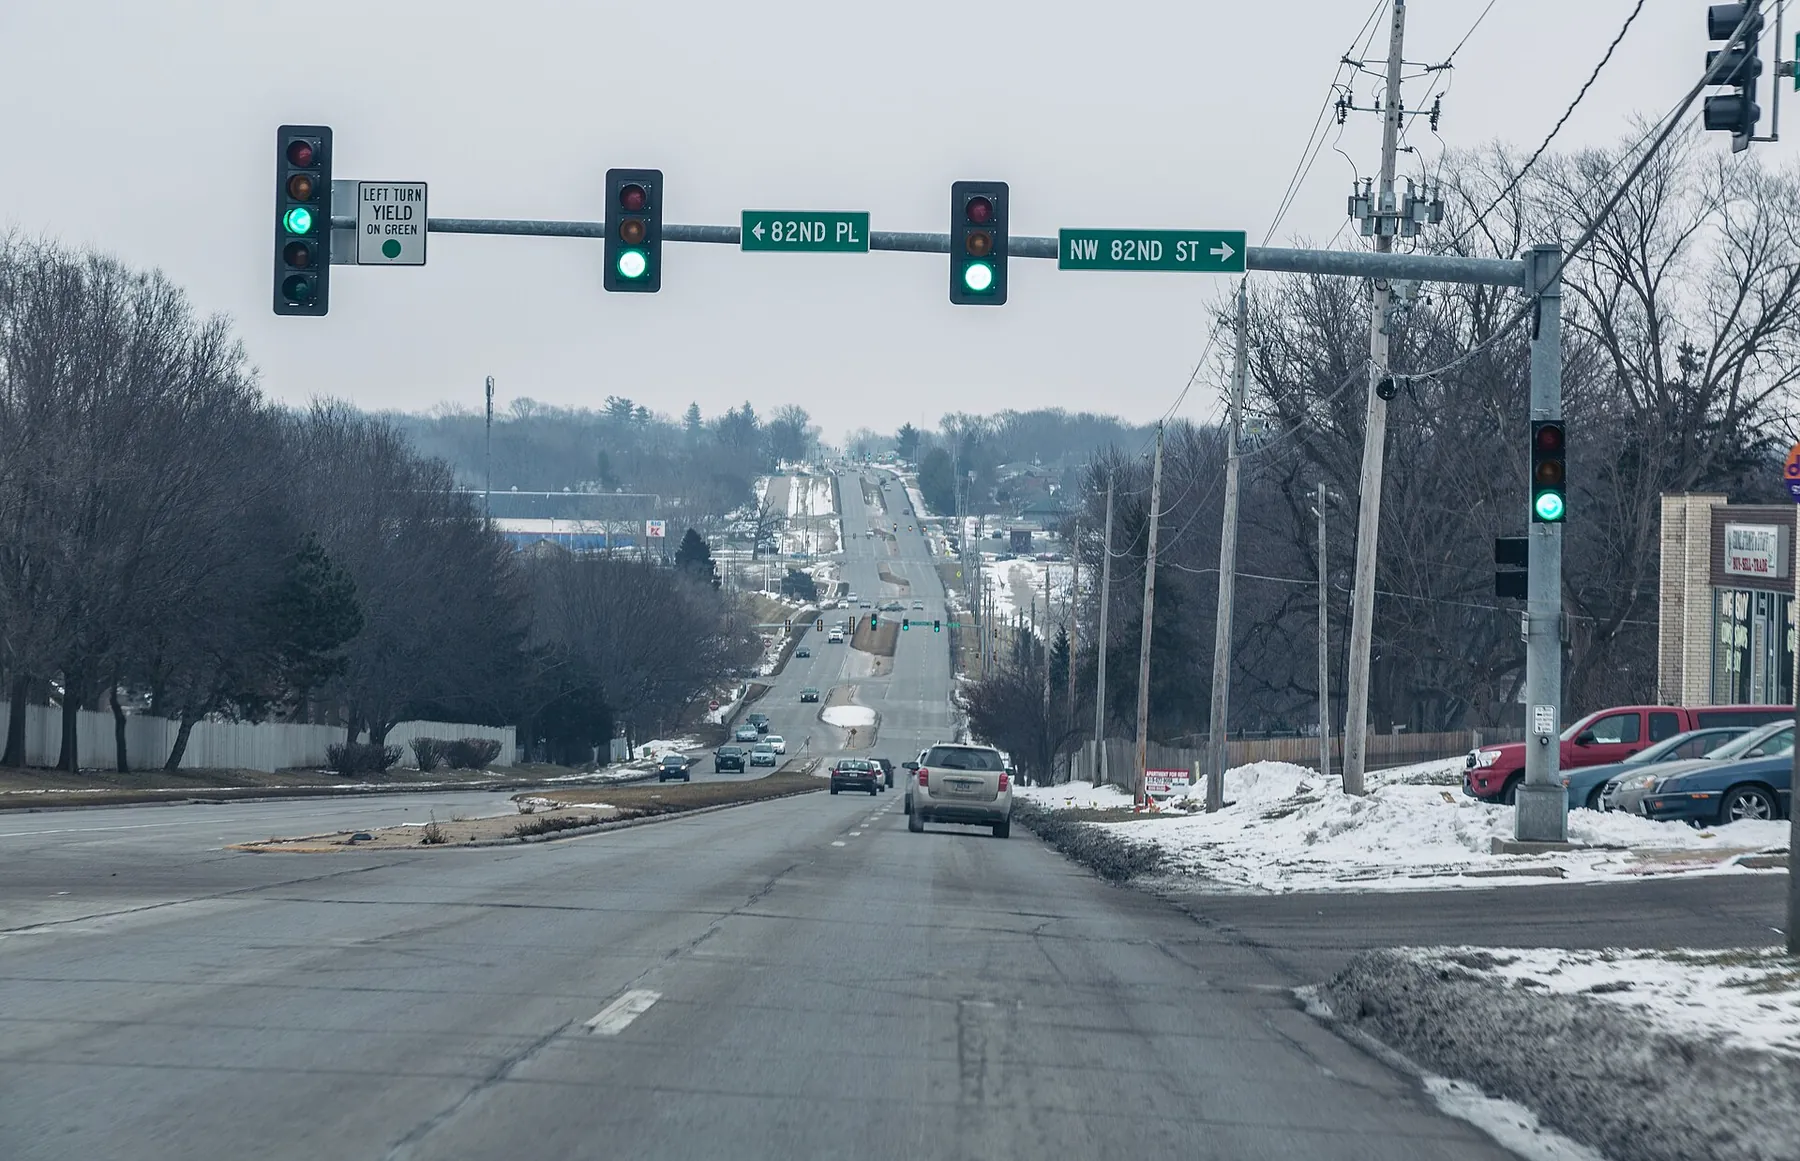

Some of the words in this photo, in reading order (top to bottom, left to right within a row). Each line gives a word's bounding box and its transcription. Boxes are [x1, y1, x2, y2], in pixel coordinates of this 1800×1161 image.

[364, 188, 389, 201] LEFT
[394, 188, 422, 202] TURN
[373, 205, 413, 221] YIELD
[367, 224, 381, 235] ON
[385, 224, 418, 235] GREEN
[771, 221, 826, 242] 82ND
[836, 221, 860, 243] PL
[1070, 239, 1099, 260] NW
[1110, 239, 1163, 261] 82ND
[1175, 240, 1200, 262] ST
[650, 527, 661, 536] K
[1722, 591, 1733, 618] WE
[1735, 591, 1749, 621] BUY
